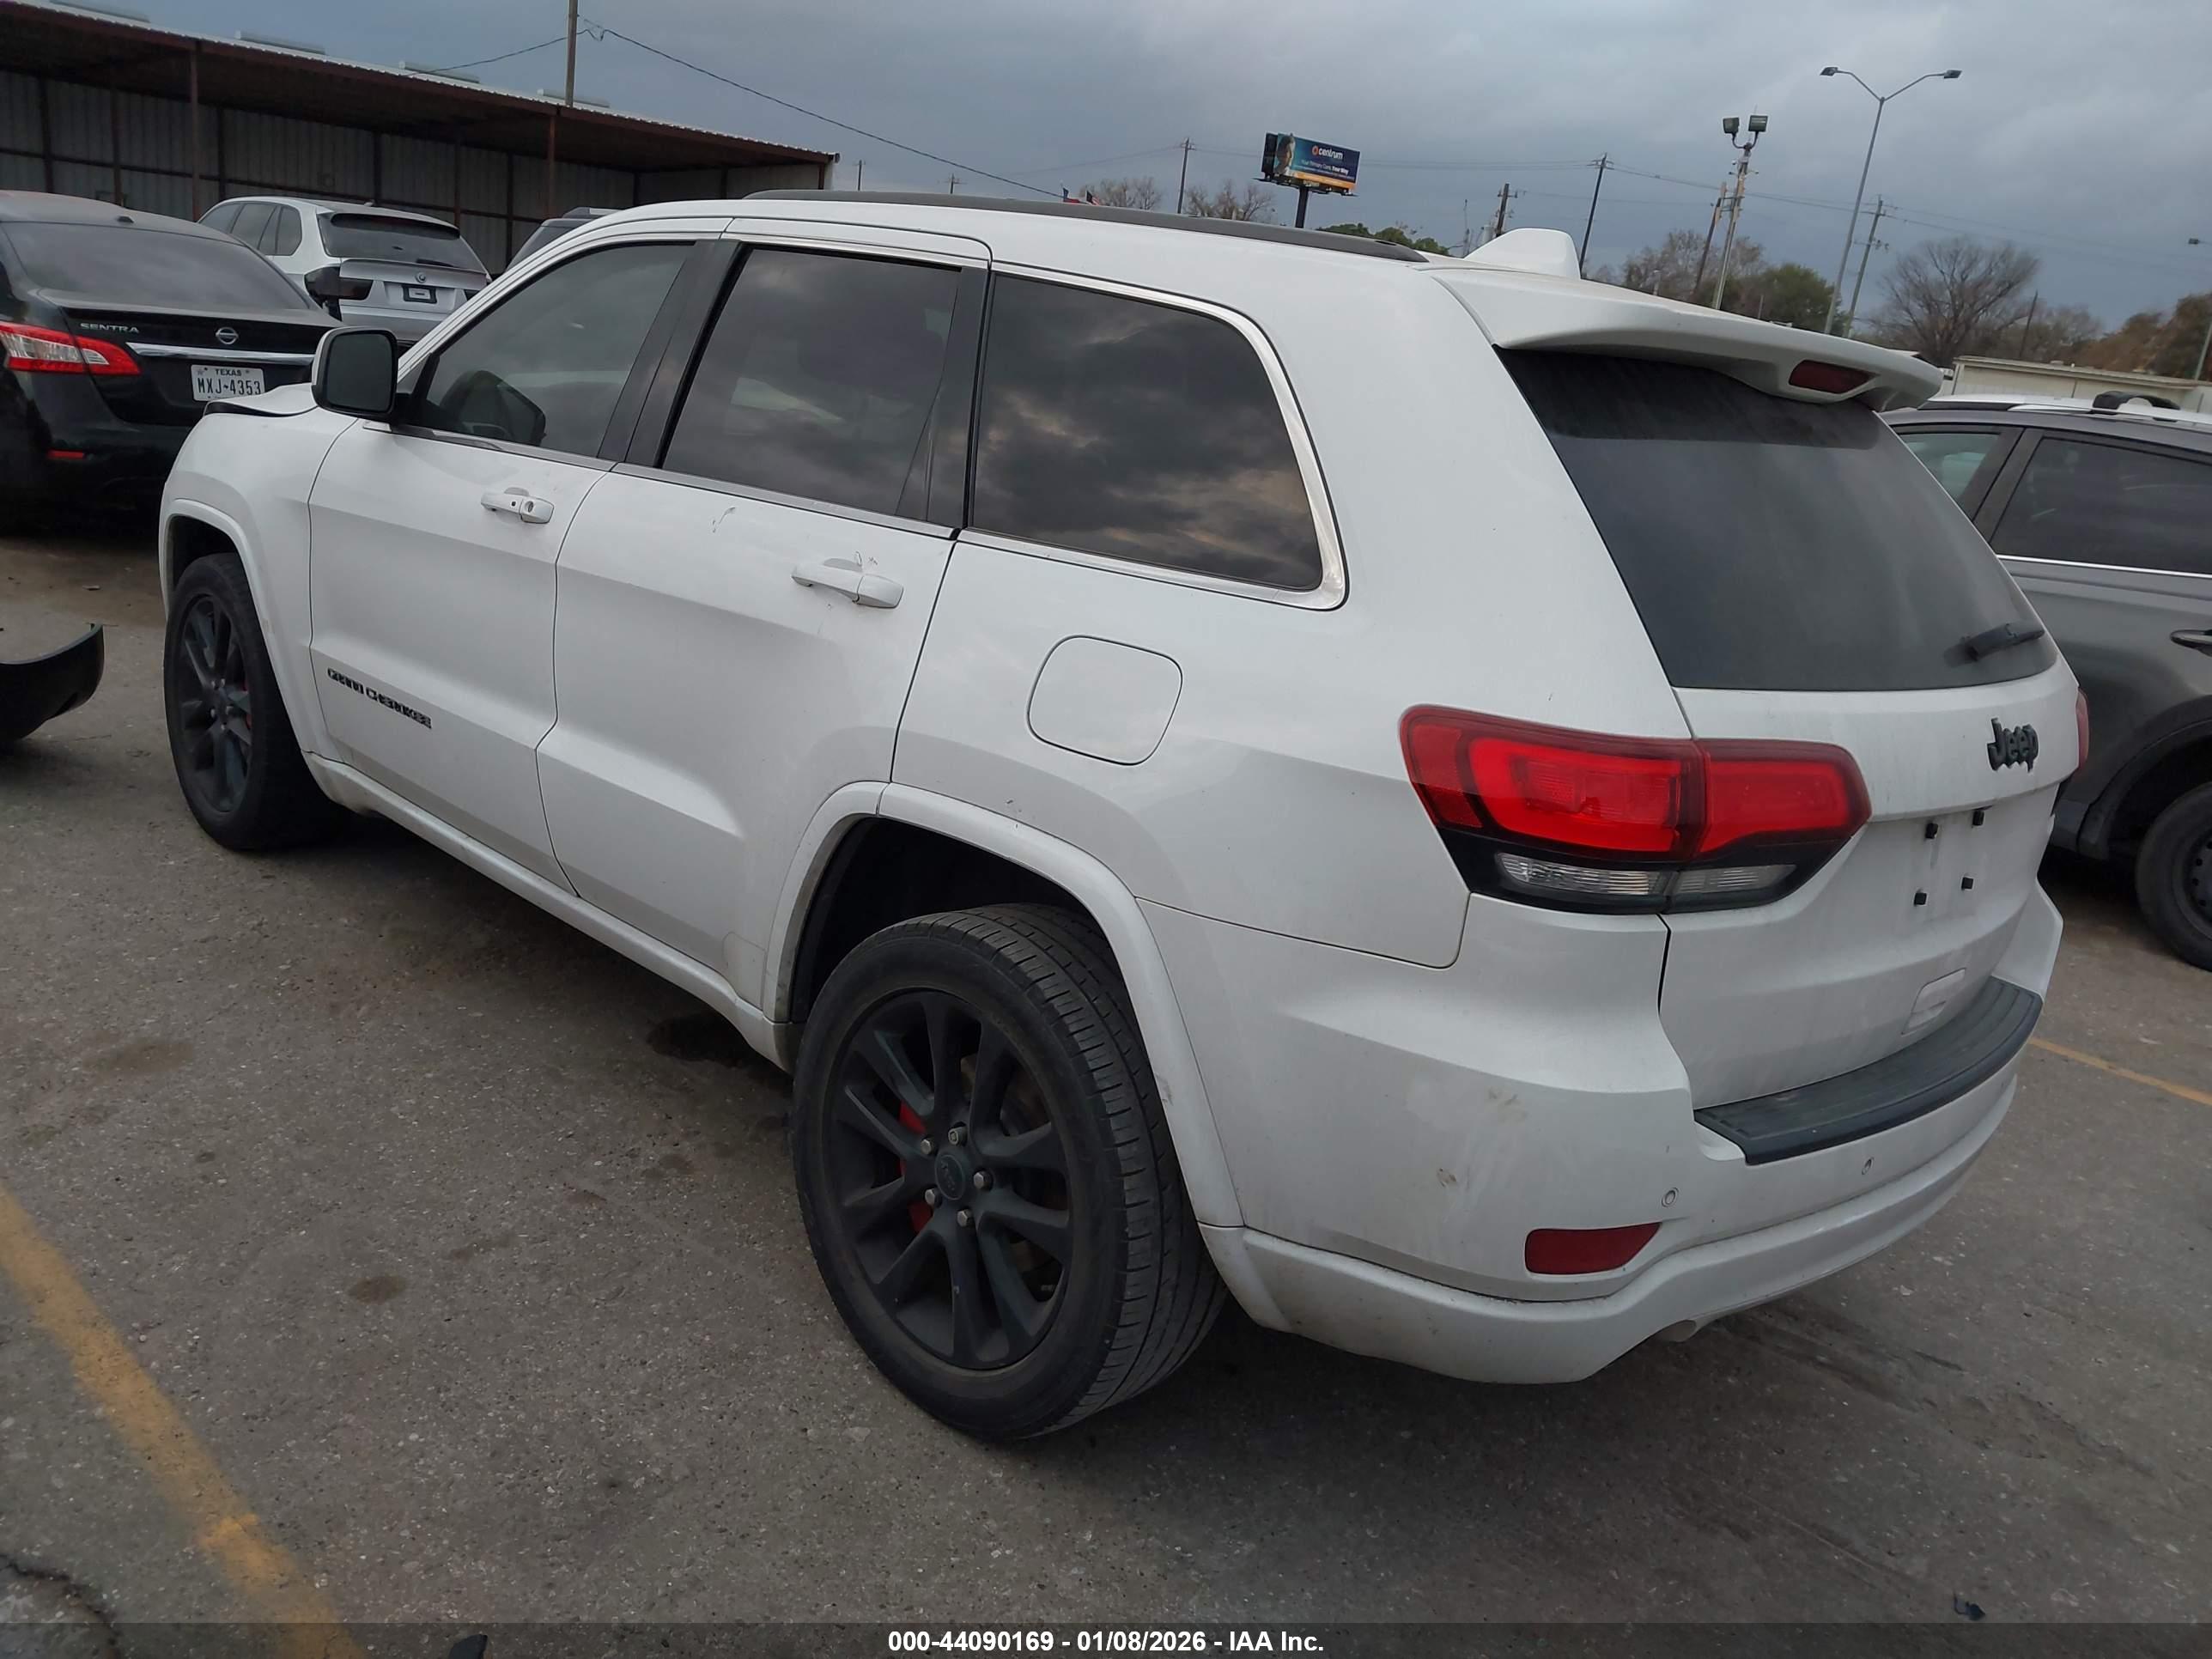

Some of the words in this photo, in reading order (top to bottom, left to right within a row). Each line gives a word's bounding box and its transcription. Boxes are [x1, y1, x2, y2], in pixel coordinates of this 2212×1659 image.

[1318, 148, 1343, 159] centrum
[80, 323, 140, 333] SENTRA
[1987, 717, 2039, 773] Jeep
